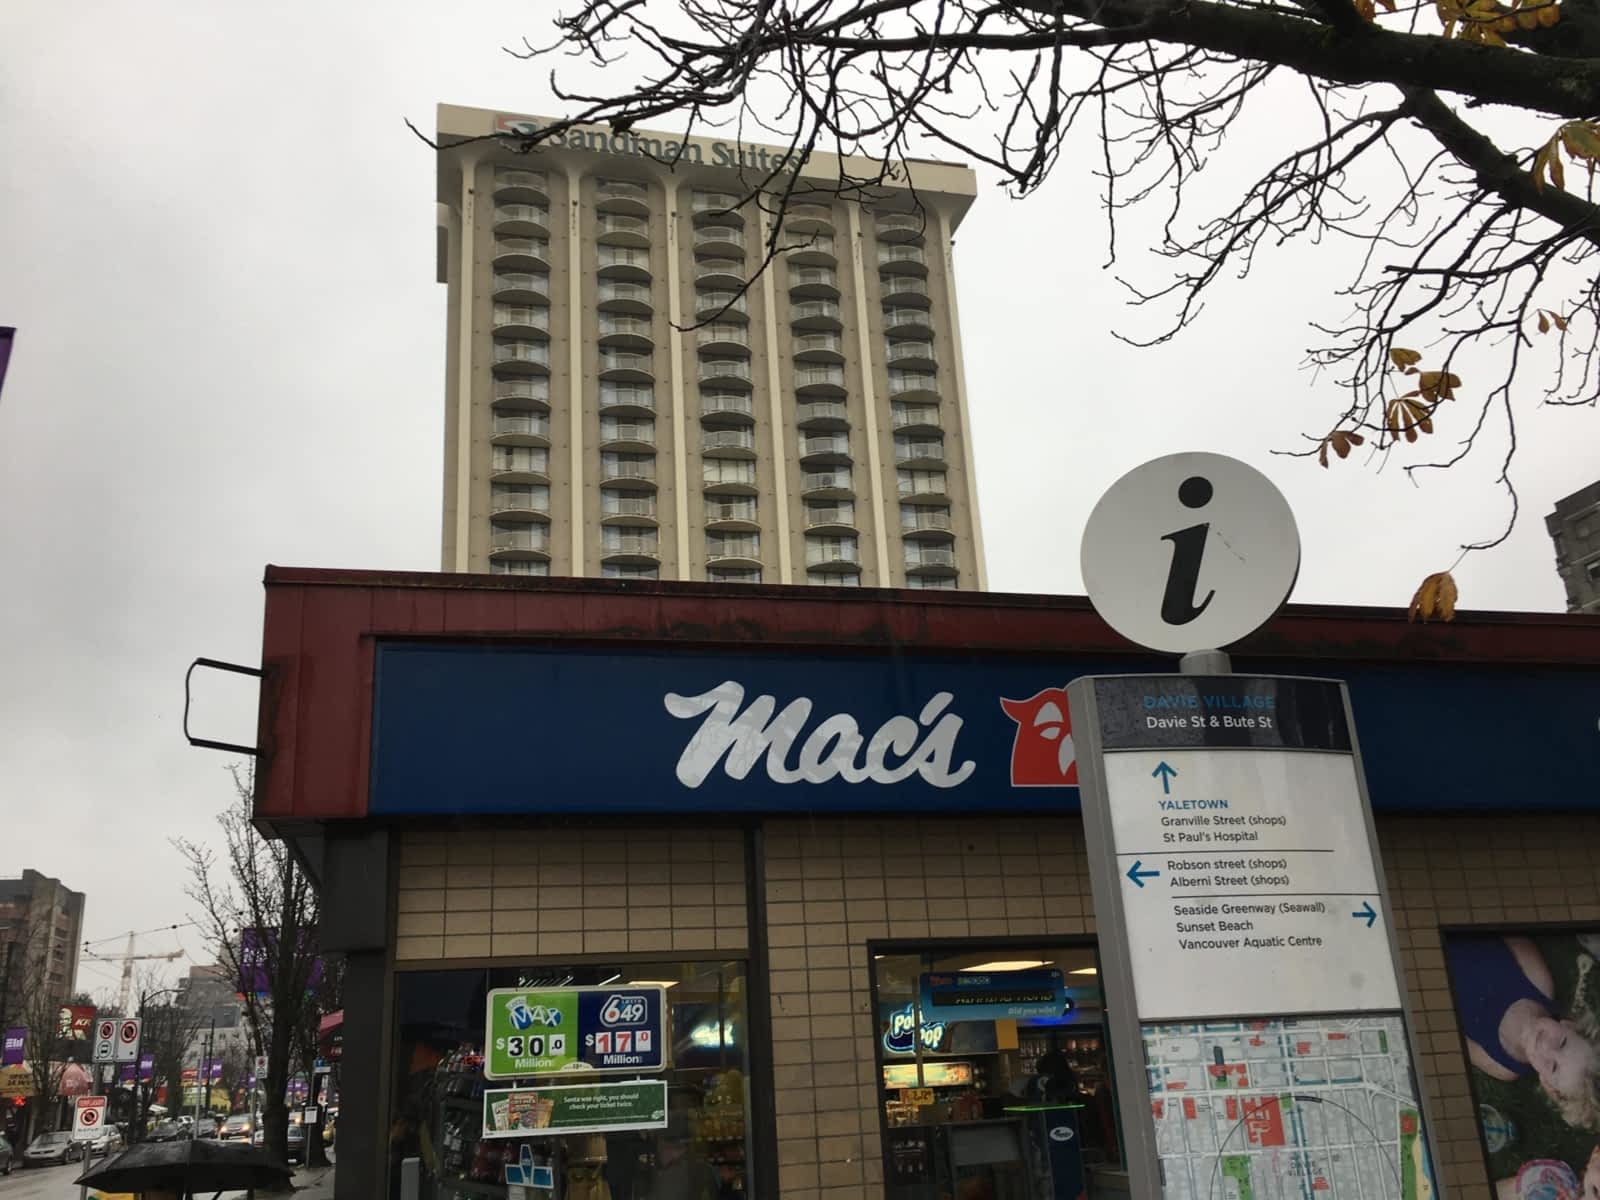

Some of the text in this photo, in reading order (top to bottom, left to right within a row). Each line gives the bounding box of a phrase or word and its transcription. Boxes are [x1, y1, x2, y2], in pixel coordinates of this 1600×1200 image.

[1143, 695, 1276, 709] DAVIE VILLAGE
[1146, 715, 1272, 728] Davie St & Bute St
[664, 680, 976, 789] Mac's
[1158, 799, 1228, 811] YALETOWN
[1161, 814, 1287, 827] Granville Street (shops)
[1163, 830, 1258, 843] St Paul's Hospital
[1167, 857, 1287, 871] Robson street (shops)
[1170, 873, 1289, 887] Alberni Street (shops)
[1174, 901, 1325, 916] Seaside Greenway (Seawall)
[1176, 920, 1254, 933] Sunset Beach
[1179, 935, 1323, 950] Vancouver Aquatic Centre
[515, 1057, 551, 1068] Million
[603, 1053, 639, 1065] Million
